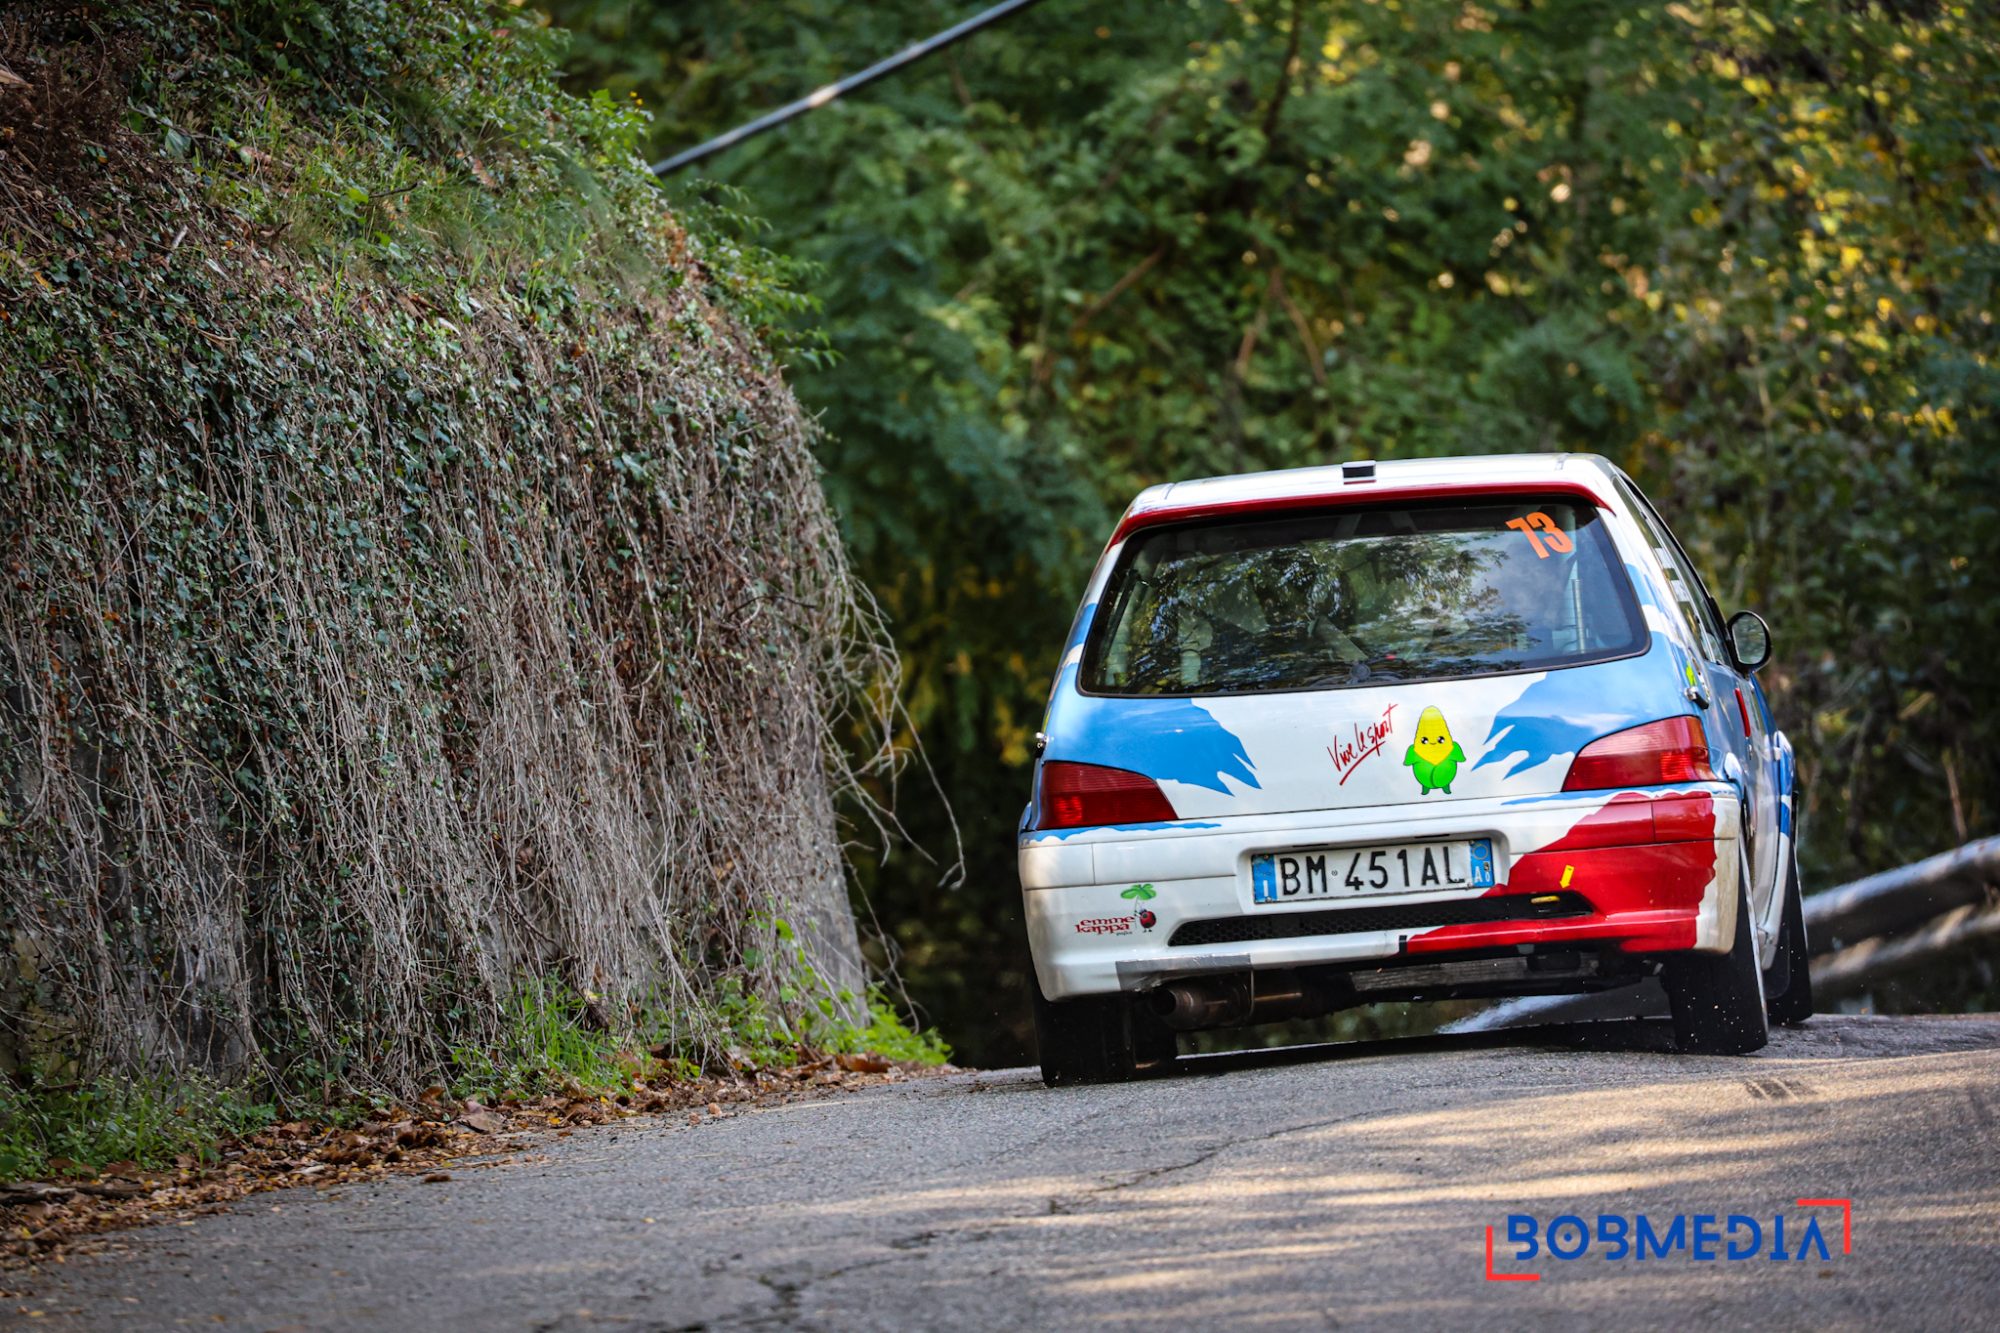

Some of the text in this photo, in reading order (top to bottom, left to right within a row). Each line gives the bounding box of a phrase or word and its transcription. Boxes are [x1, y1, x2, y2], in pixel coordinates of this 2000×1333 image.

[1505, 511, 1573, 559] 73
[1279, 854, 1328, 896] BM
[1074, 923, 1130, 935] kappa
[1080, 916, 1135, 926] emme
